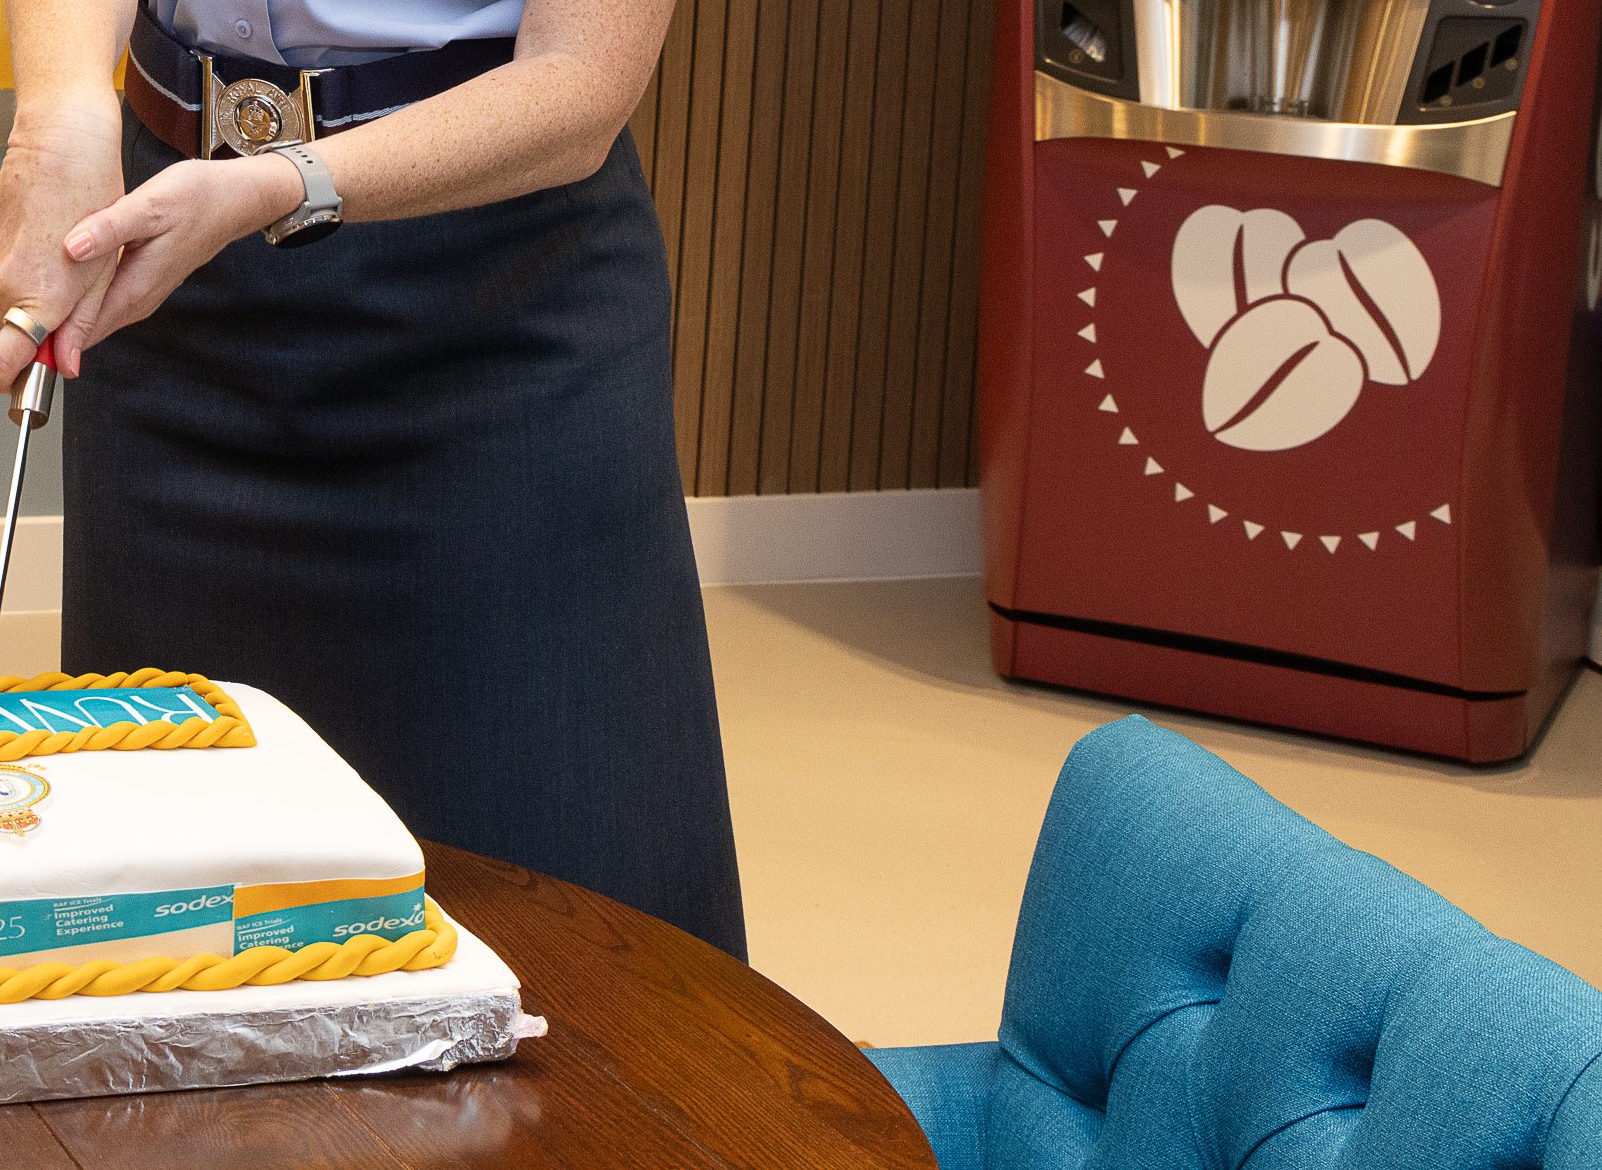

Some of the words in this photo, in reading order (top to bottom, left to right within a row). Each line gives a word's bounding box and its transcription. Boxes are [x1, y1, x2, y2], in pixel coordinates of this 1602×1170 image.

[54, 904, 114, 919] Improved
[153, 894, 235, 918] sodex
[56, 915, 108, 928] Catering
[333, 903, 425, 938] sodexo
[57, 921, 124, 936] Experience
[237, 924, 295, 942] Improved
[239, 936, 290, 950] Catering
